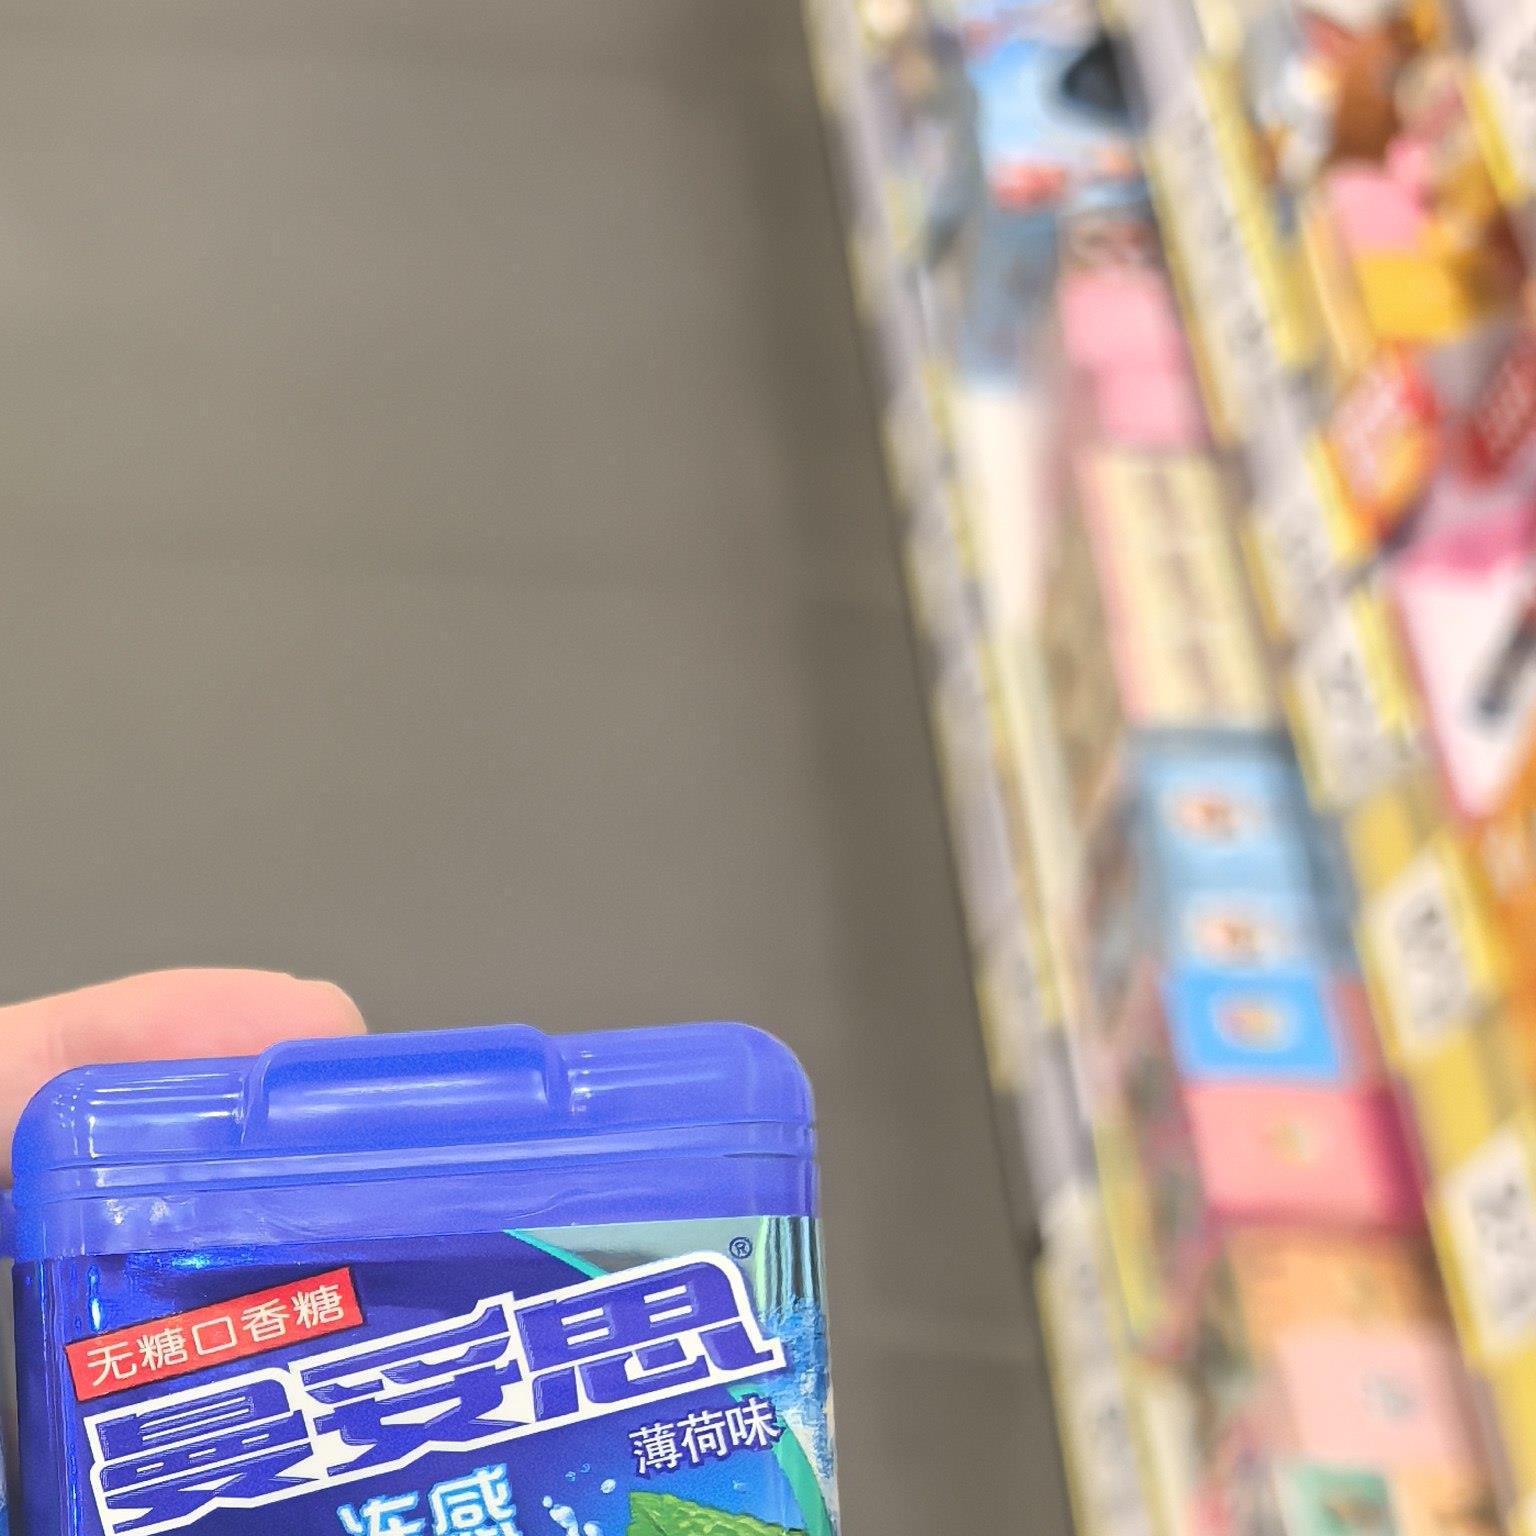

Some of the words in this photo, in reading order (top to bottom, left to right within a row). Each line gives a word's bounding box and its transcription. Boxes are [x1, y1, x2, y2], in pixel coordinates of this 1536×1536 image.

[88, 1284, 344, 1387] 无糖口香糖
[628, 1397, 780, 1474] 薄荷味
